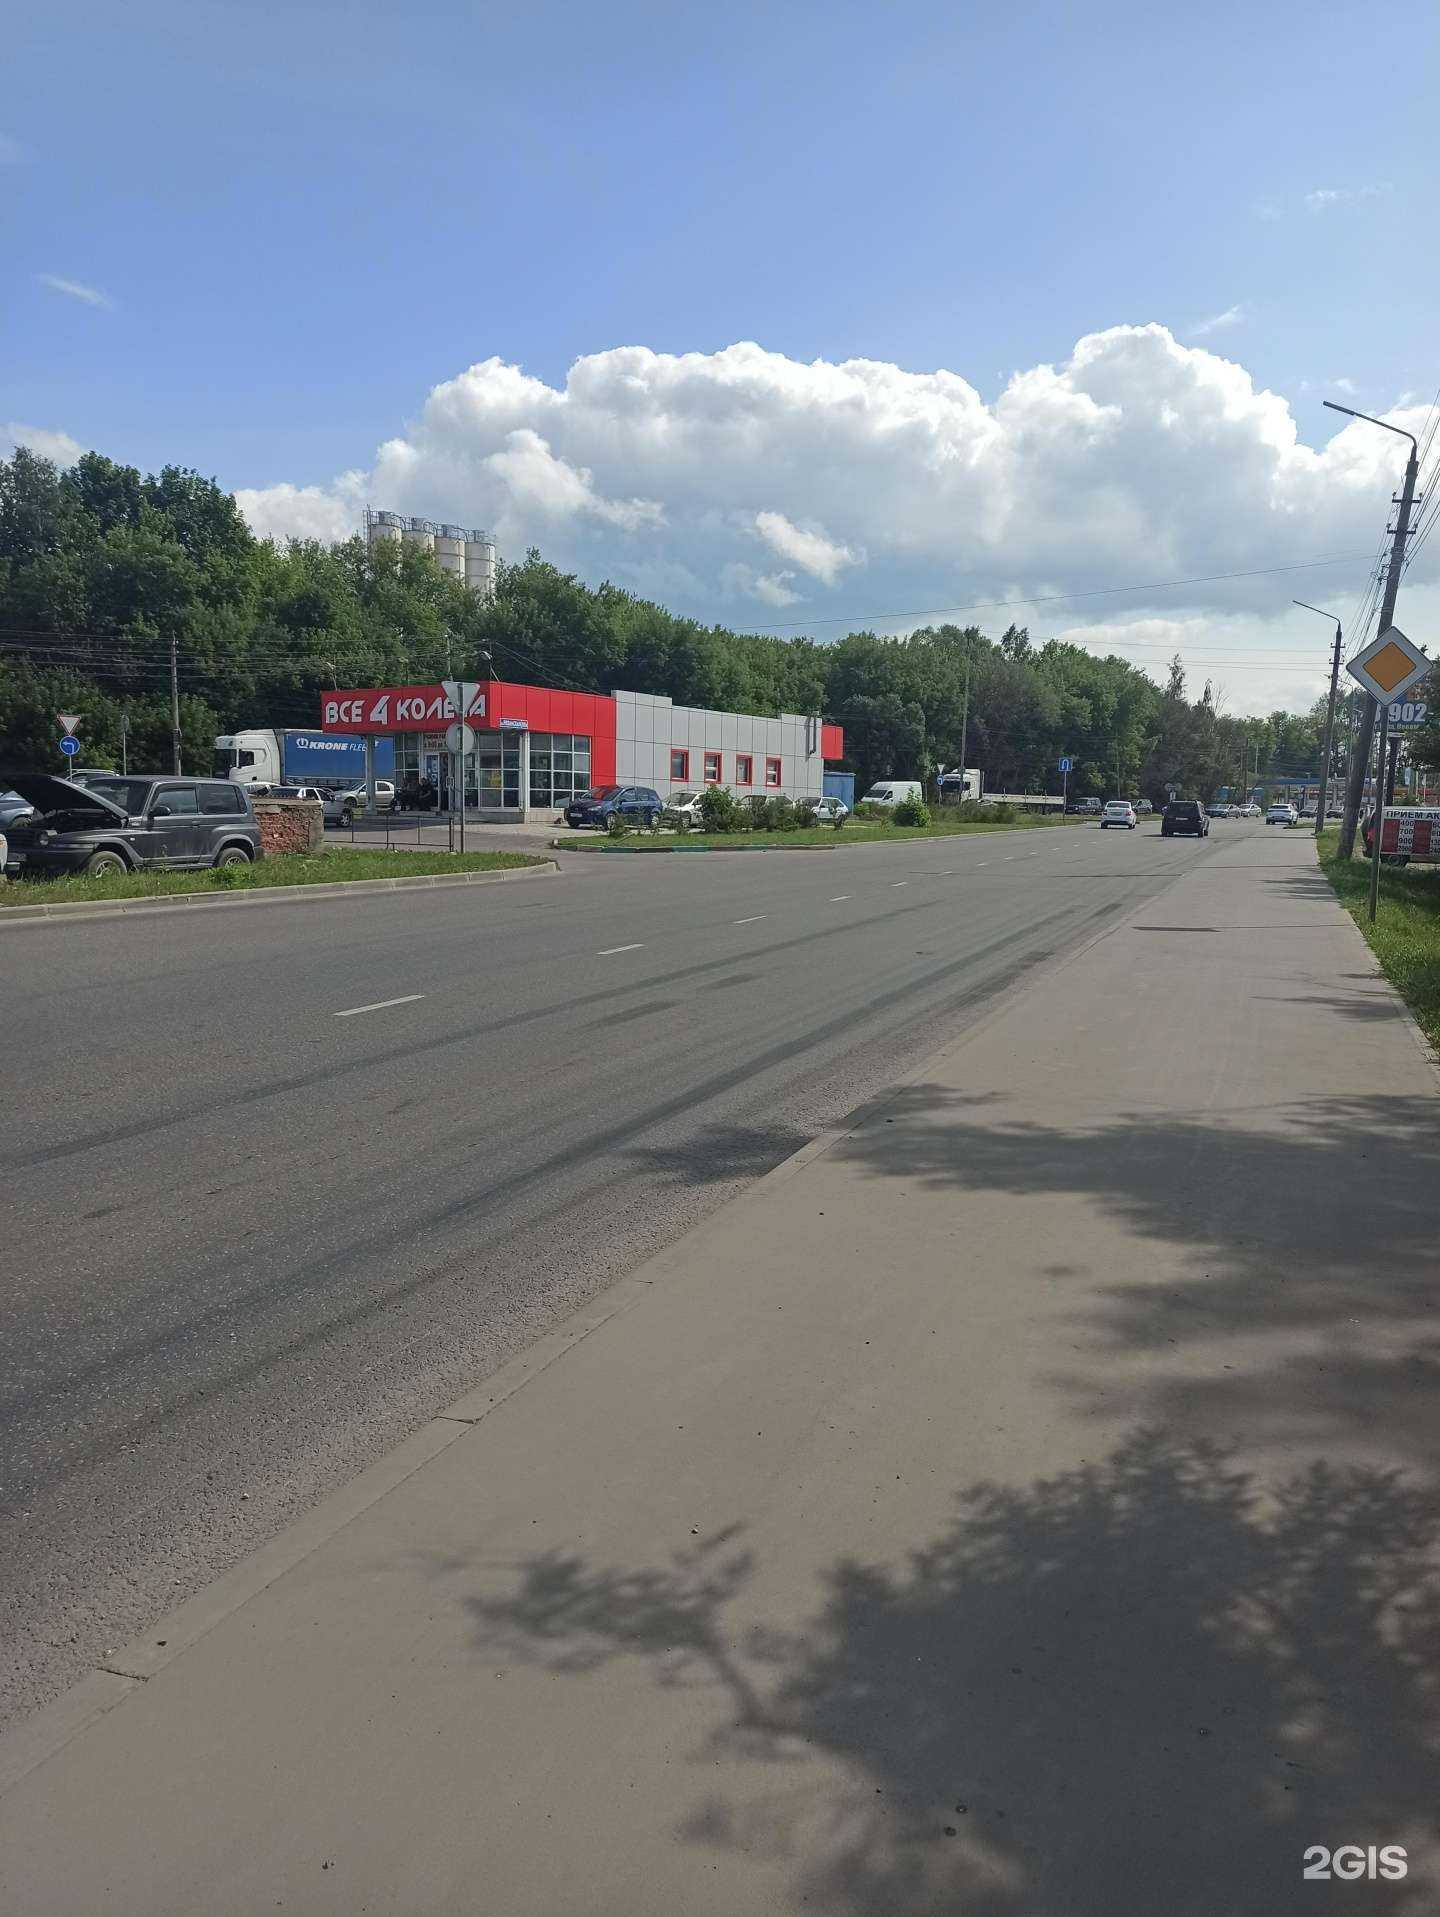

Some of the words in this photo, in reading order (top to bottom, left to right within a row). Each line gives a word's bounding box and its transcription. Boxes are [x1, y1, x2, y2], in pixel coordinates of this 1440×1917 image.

[325, 700, 366, 724] ВСЕ
[369, 695, 391, 725] 4
[396, 694, 486, 722] КОЛЕА
[309, 741, 348, 751] KRONE
[1386, 810, 1423, 819] ПРИЕМ
